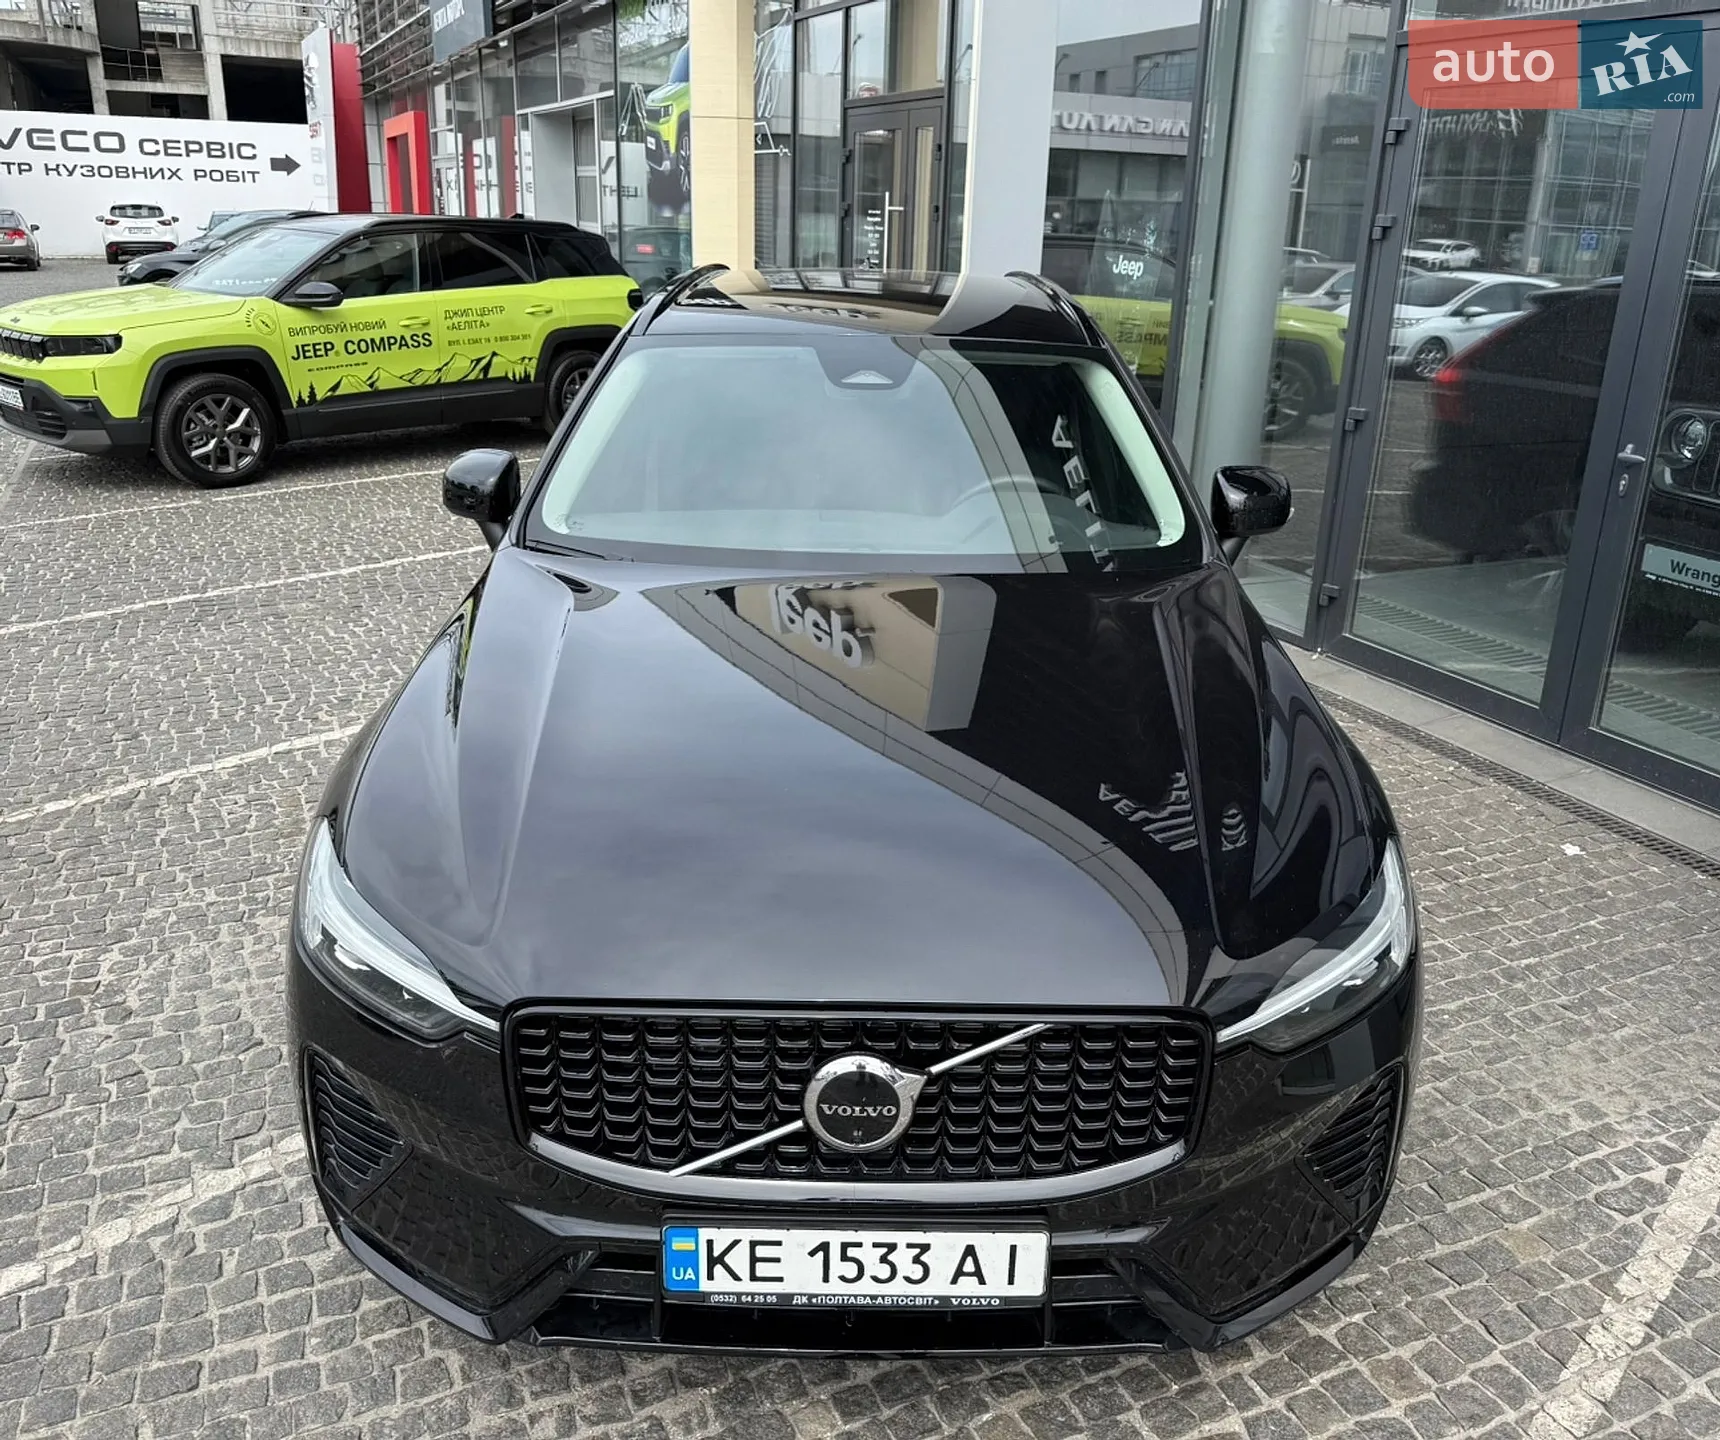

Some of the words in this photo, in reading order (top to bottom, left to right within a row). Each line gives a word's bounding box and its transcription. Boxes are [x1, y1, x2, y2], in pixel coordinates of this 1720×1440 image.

[138, 137, 259, 161] СЕРВІС
[44, 163, 184, 183] КУЗОВНИХ
[194, 168, 261, 184] РОБІТ
[1112, 254, 1144, 281] Jeep
[443, 307, 474, 321] ДЖИП
[475, 305, 506, 319] ЦЕНТР
[287, 321, 348, 338] ВИПРОБУЙ
[349, 318, 387, 333] НОВИЙ
[446, 319, 491, 332] «АЕЛІТА»
[343, 332, 433, 356] COMPASS
[819, 1103, 898, 1117] VOLVO
[705, 1238, 785, 1283] KE
[807, 1240, 932, 1285] 1533
[672, 1266, 696, 1281] UA
[710, 1293, 738, 1304] (0532)
[741, 1293, 752, 1304] 64
[754, 1293, 765, 1304] 25
[766, 1294, 778, 1304] 05
[792, 1295, 809, 1306] ДК
[811, 1294, 940, 1307] «ПОЛТАВА-АВТОСВІТ»
[950, 1296, 1000, 1306] VOLVO
